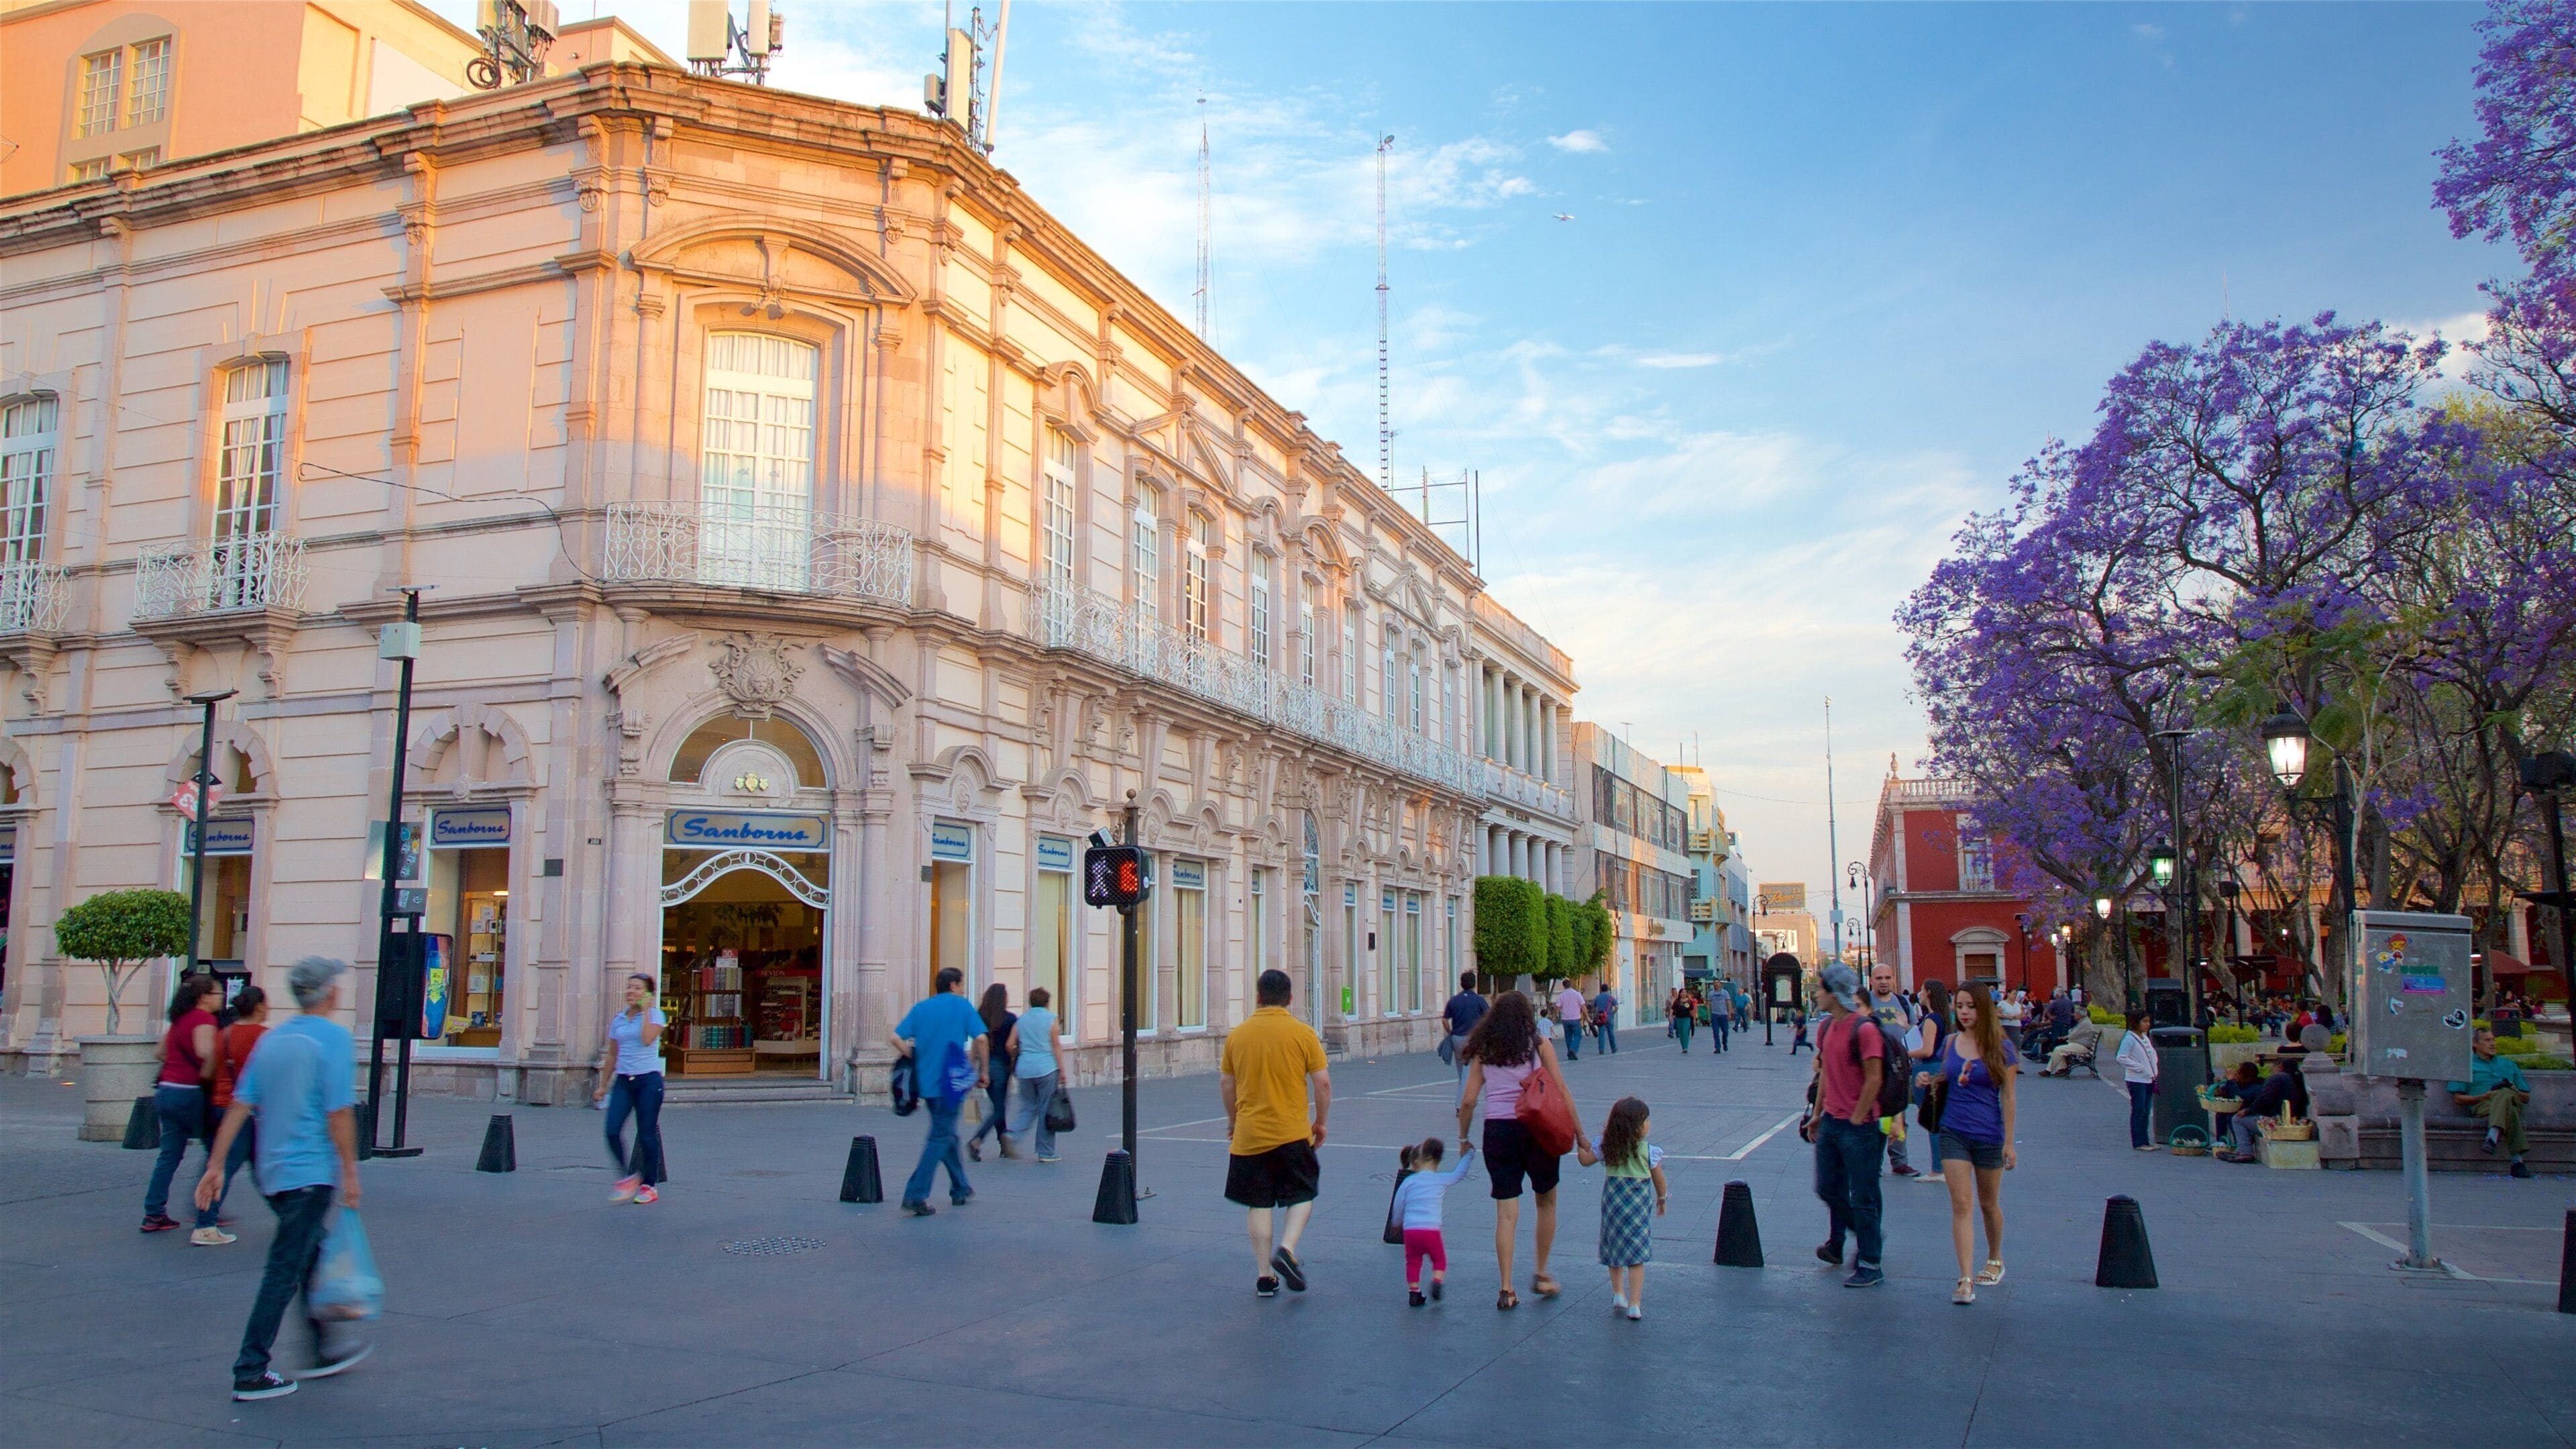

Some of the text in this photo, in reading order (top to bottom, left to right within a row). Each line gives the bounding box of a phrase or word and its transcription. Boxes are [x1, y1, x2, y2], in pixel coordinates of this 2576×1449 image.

[437, 820, 506, 835] Sanborns
[684, 818, 809, 841] Sanborns
[191, 830, 250, 843] Snborns
